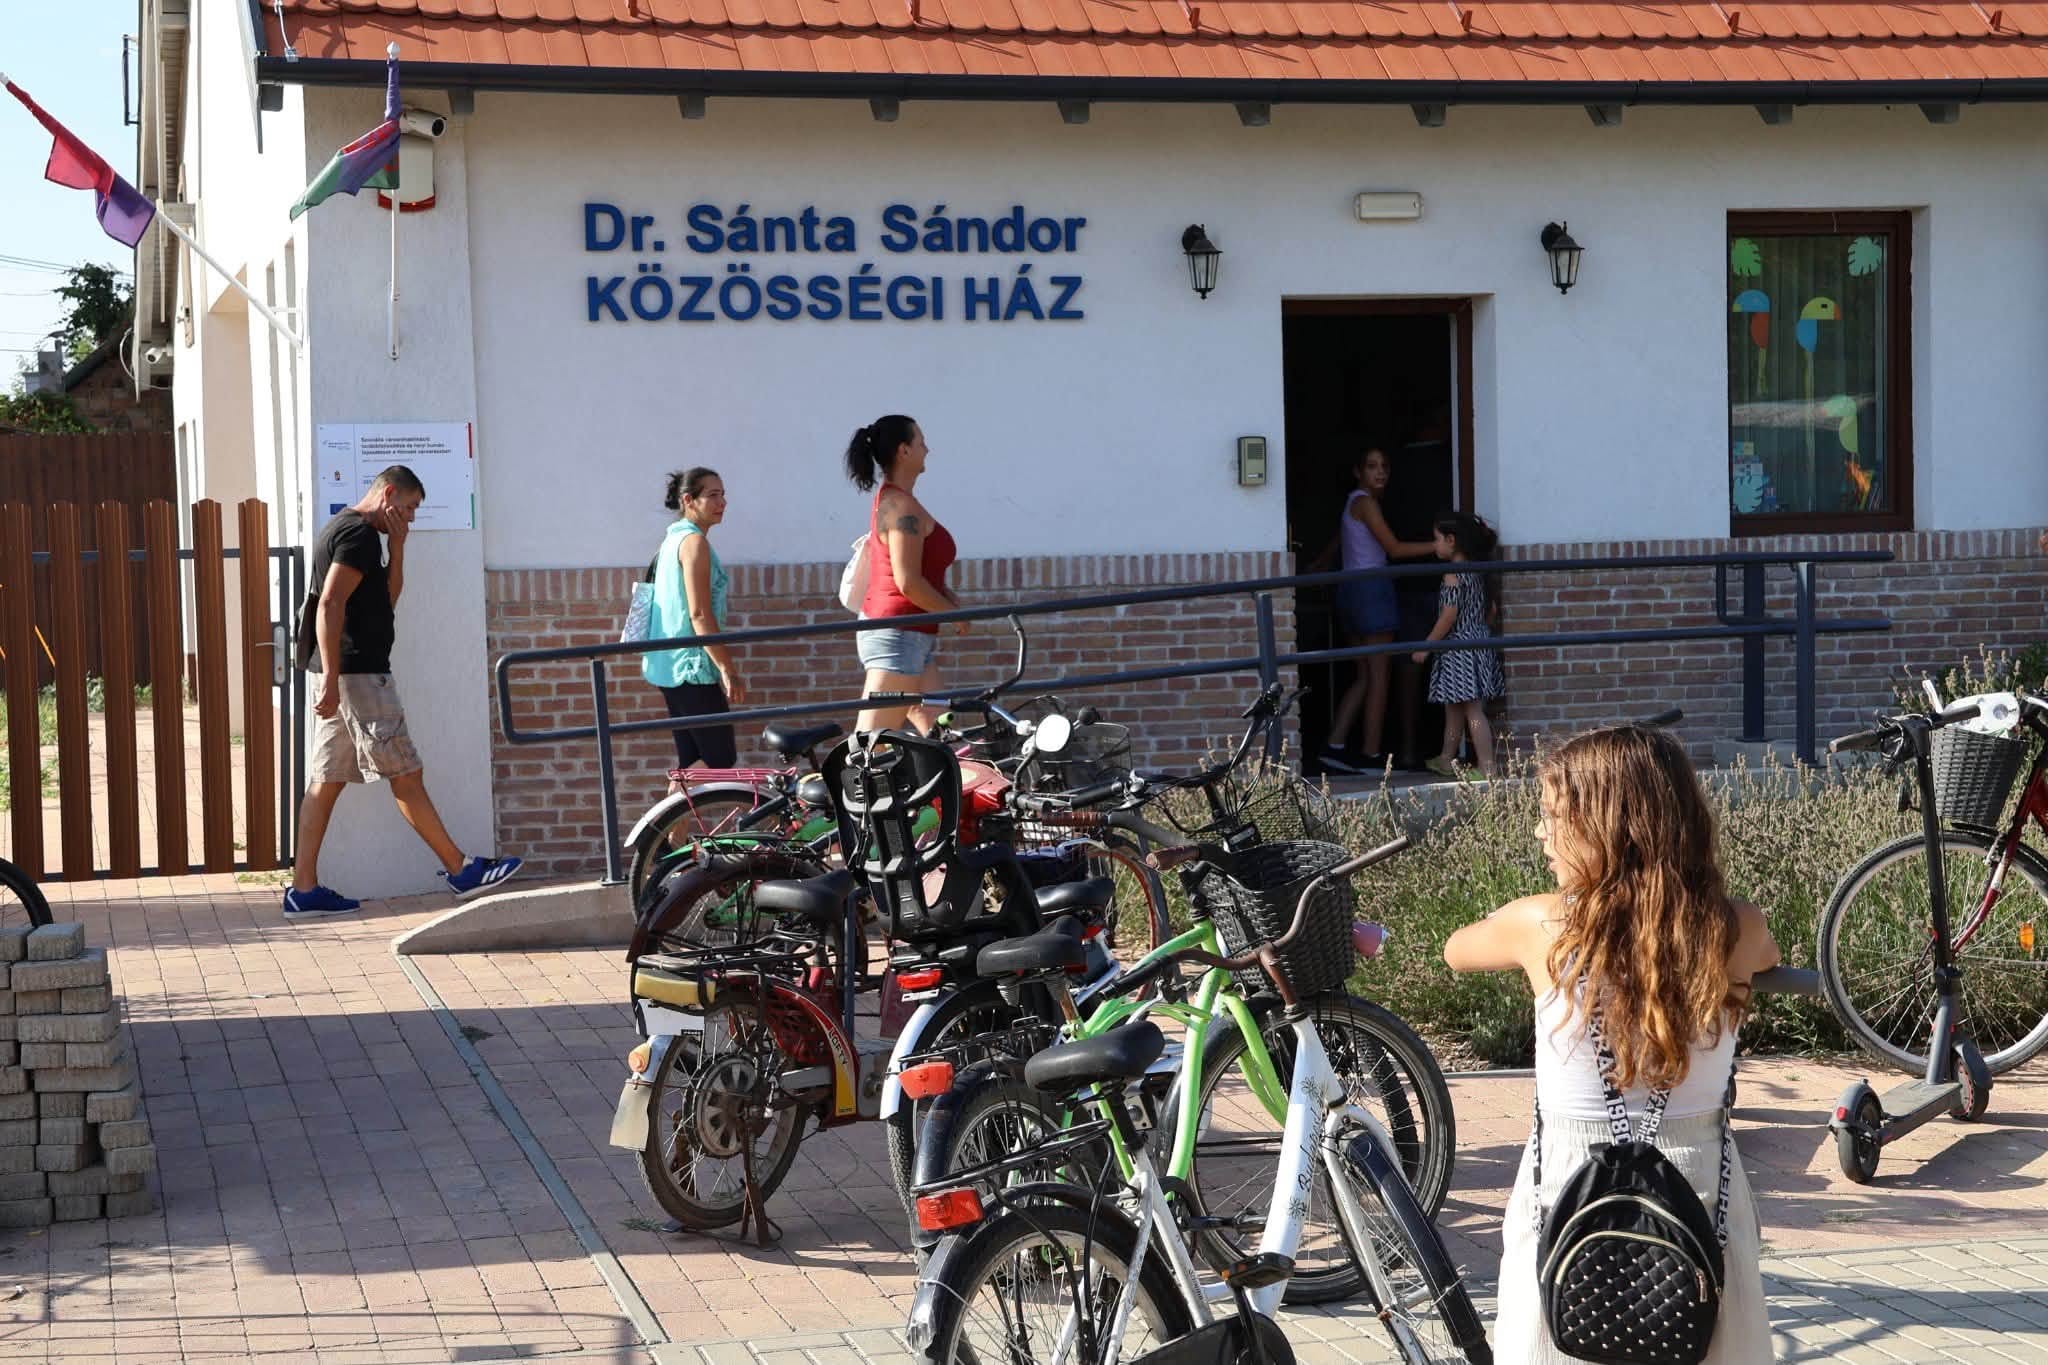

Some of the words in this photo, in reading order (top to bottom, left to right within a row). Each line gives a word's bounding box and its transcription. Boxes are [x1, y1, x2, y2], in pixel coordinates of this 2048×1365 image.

[585, 203, 665, 252] Dr.
[686, 203, 858, 253] Sánta
[880, 203, 1087, 253] Sándor
[587, 263, 945, 321] KÖZÖSSÉGI
[963, 263, 1085, 321] HÁZ
